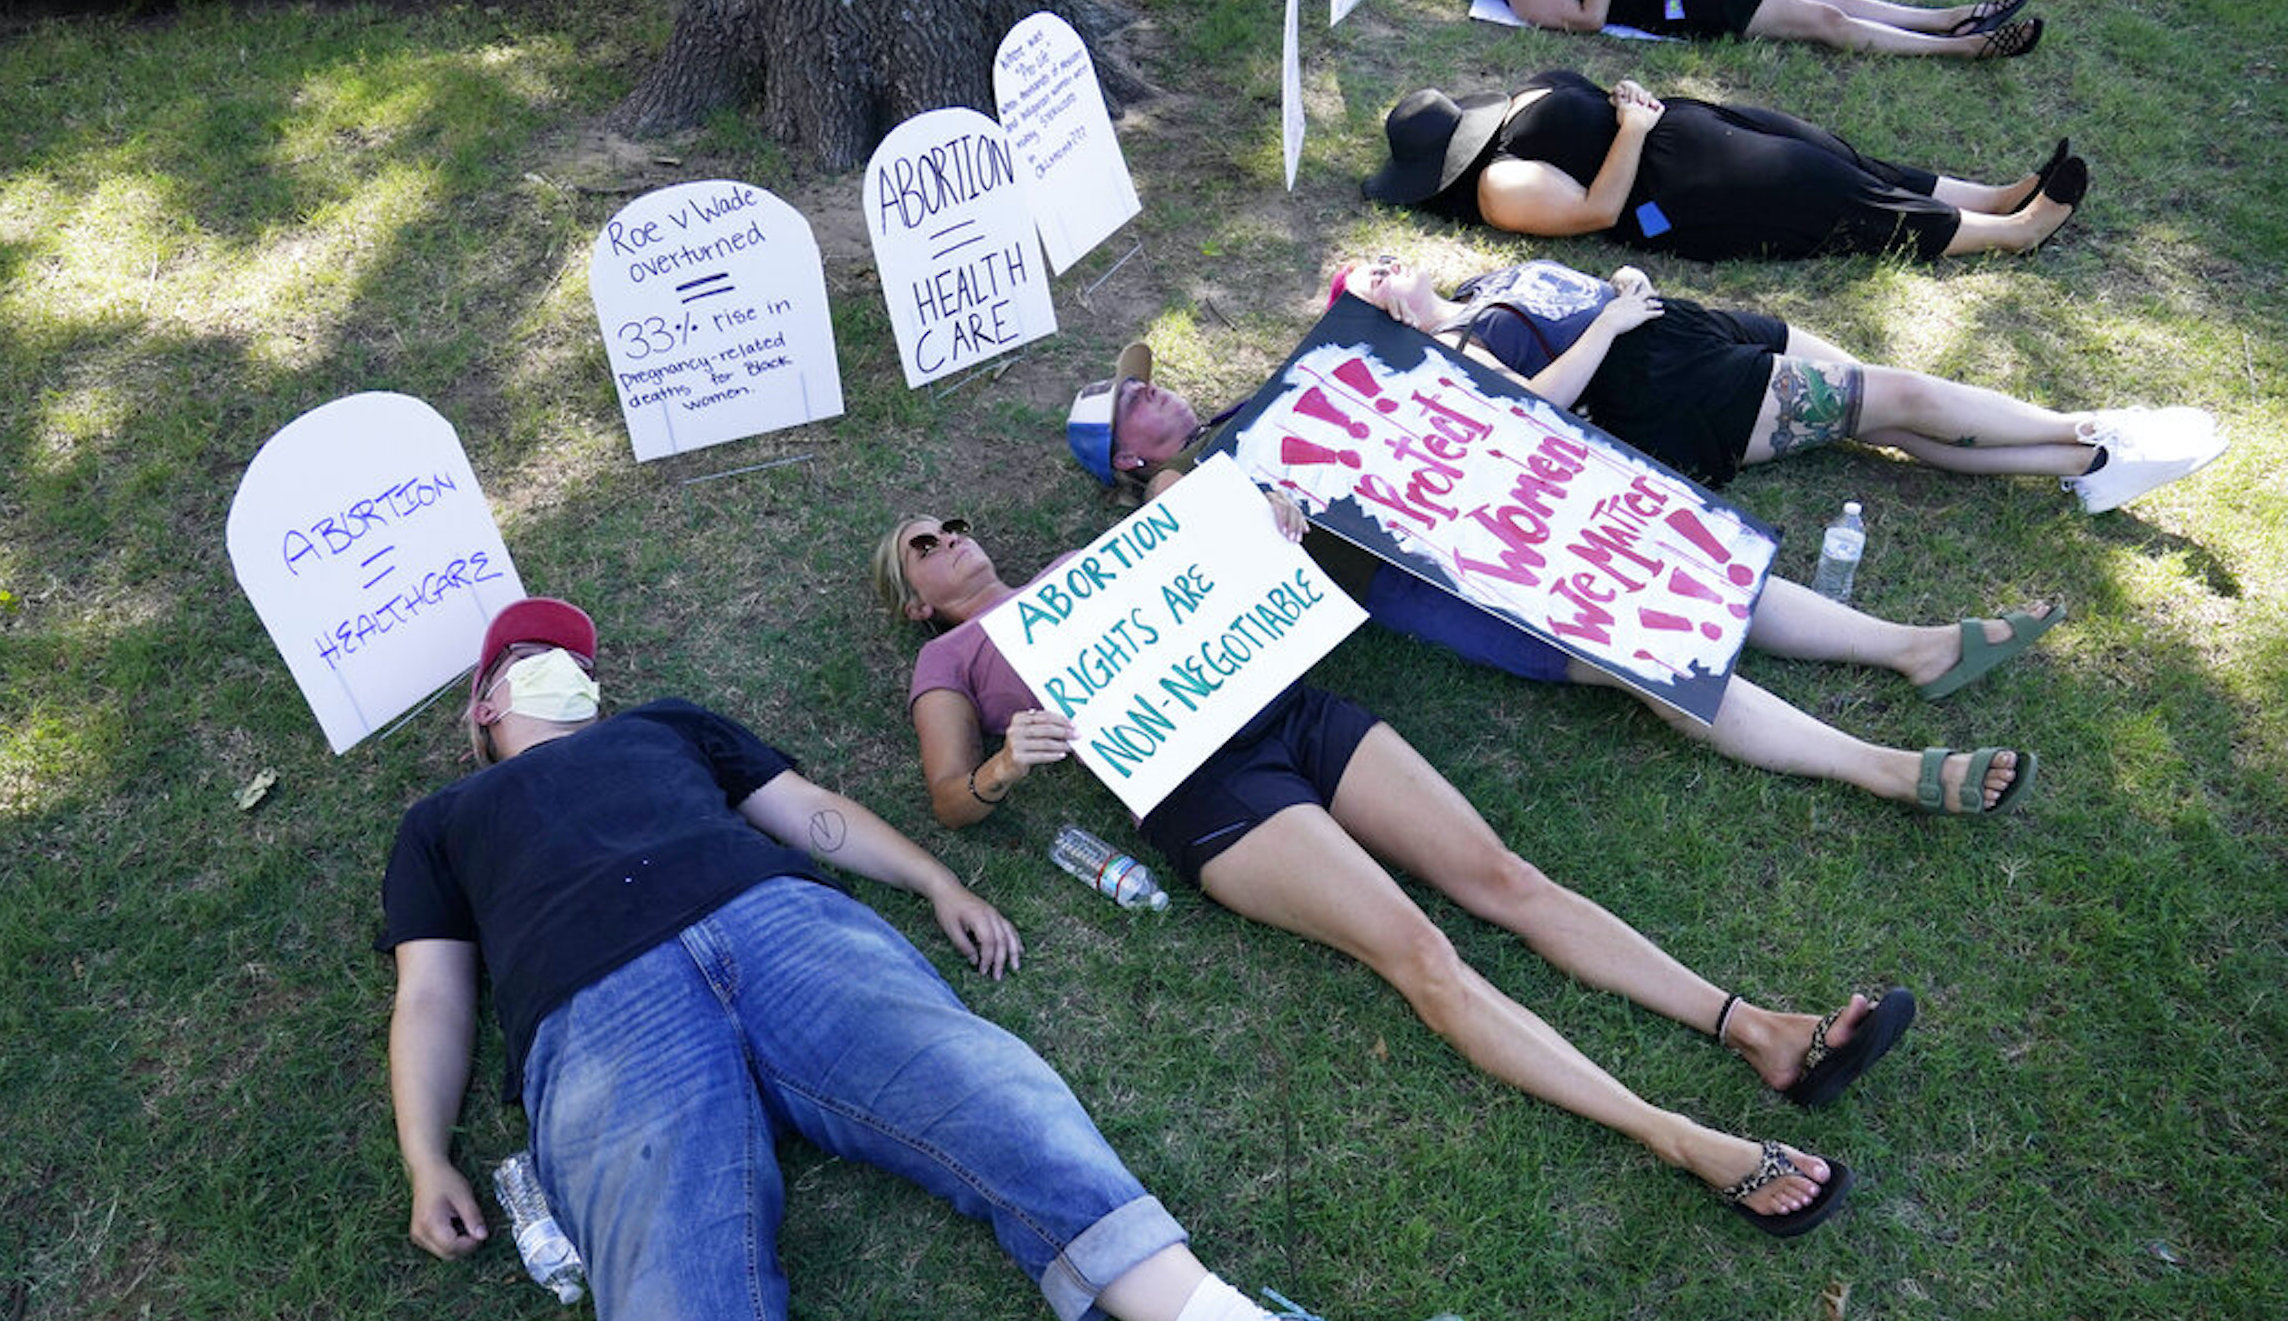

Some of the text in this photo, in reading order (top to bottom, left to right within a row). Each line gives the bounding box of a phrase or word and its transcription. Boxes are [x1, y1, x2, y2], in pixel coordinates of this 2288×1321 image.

[607, 220, 664, 256] Roe
[689, 186, 758, 224] Wade
[880, 134, 1014, 236] ABORTION
[629, 220, 766, 283] overturned
[912, 241, 1027, 326] HEALTH
[618, 298, 793, 360] 33% rise in
[916, 299, 1019, 374] CARE
[628, 383, 692, 409] deaths
[711, 372, 734, 386] for
[1353, 389, 1494, 531] Protect
[1453, 436, 1590, 587] Women
[283, 472, 458, 576] ABORTION
[1017, 501, 1180, 645] ABORTION
[314, 551, 504, 671] HEALTHCARE
[1044, 563, 1216, 720] RIGHTS ARE
[1090, 567, 1325, 779] NON-NEGOTIABLE
